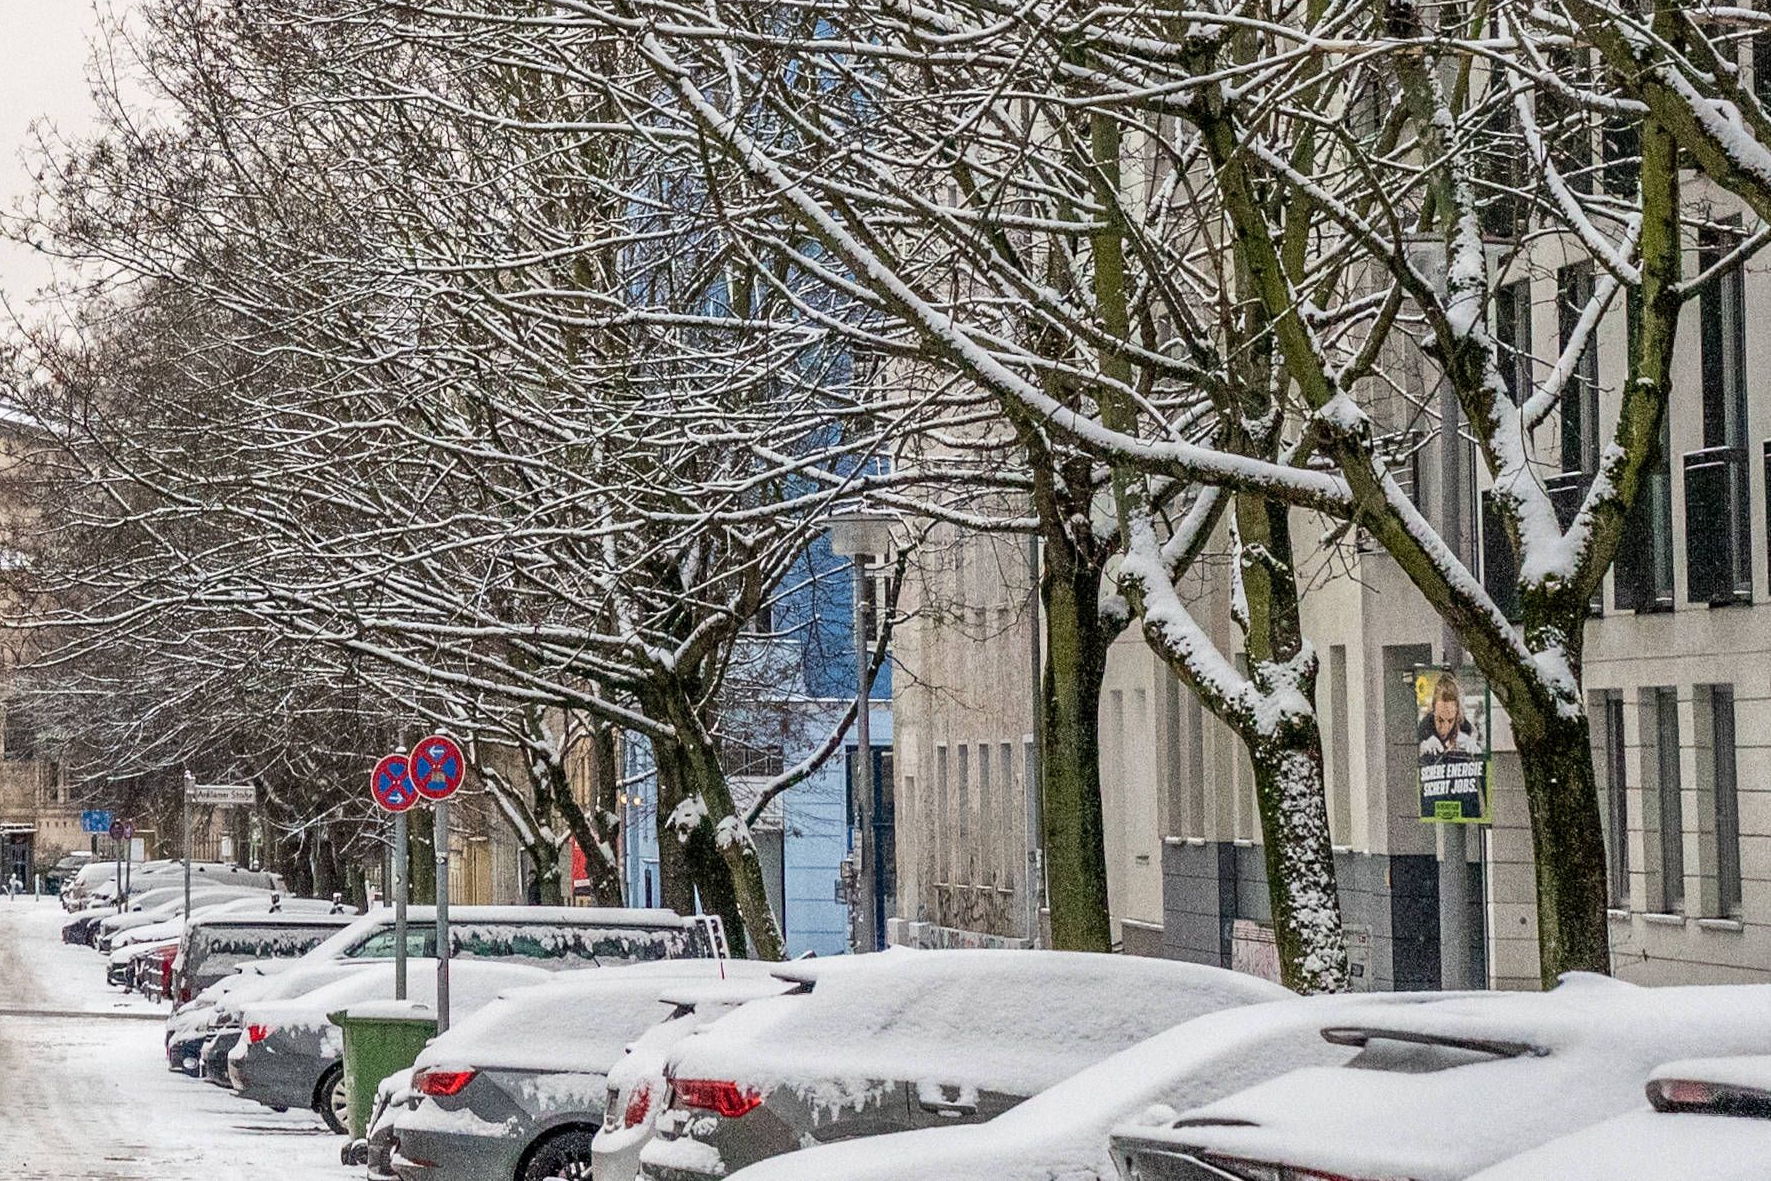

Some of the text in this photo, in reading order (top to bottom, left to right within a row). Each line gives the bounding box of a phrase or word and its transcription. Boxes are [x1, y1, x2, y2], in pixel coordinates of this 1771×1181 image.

[1421, 761, 1484, 782] SICHERE ENERGIE
[1423, 777, 1478, 797] SICHERT JOBS.
